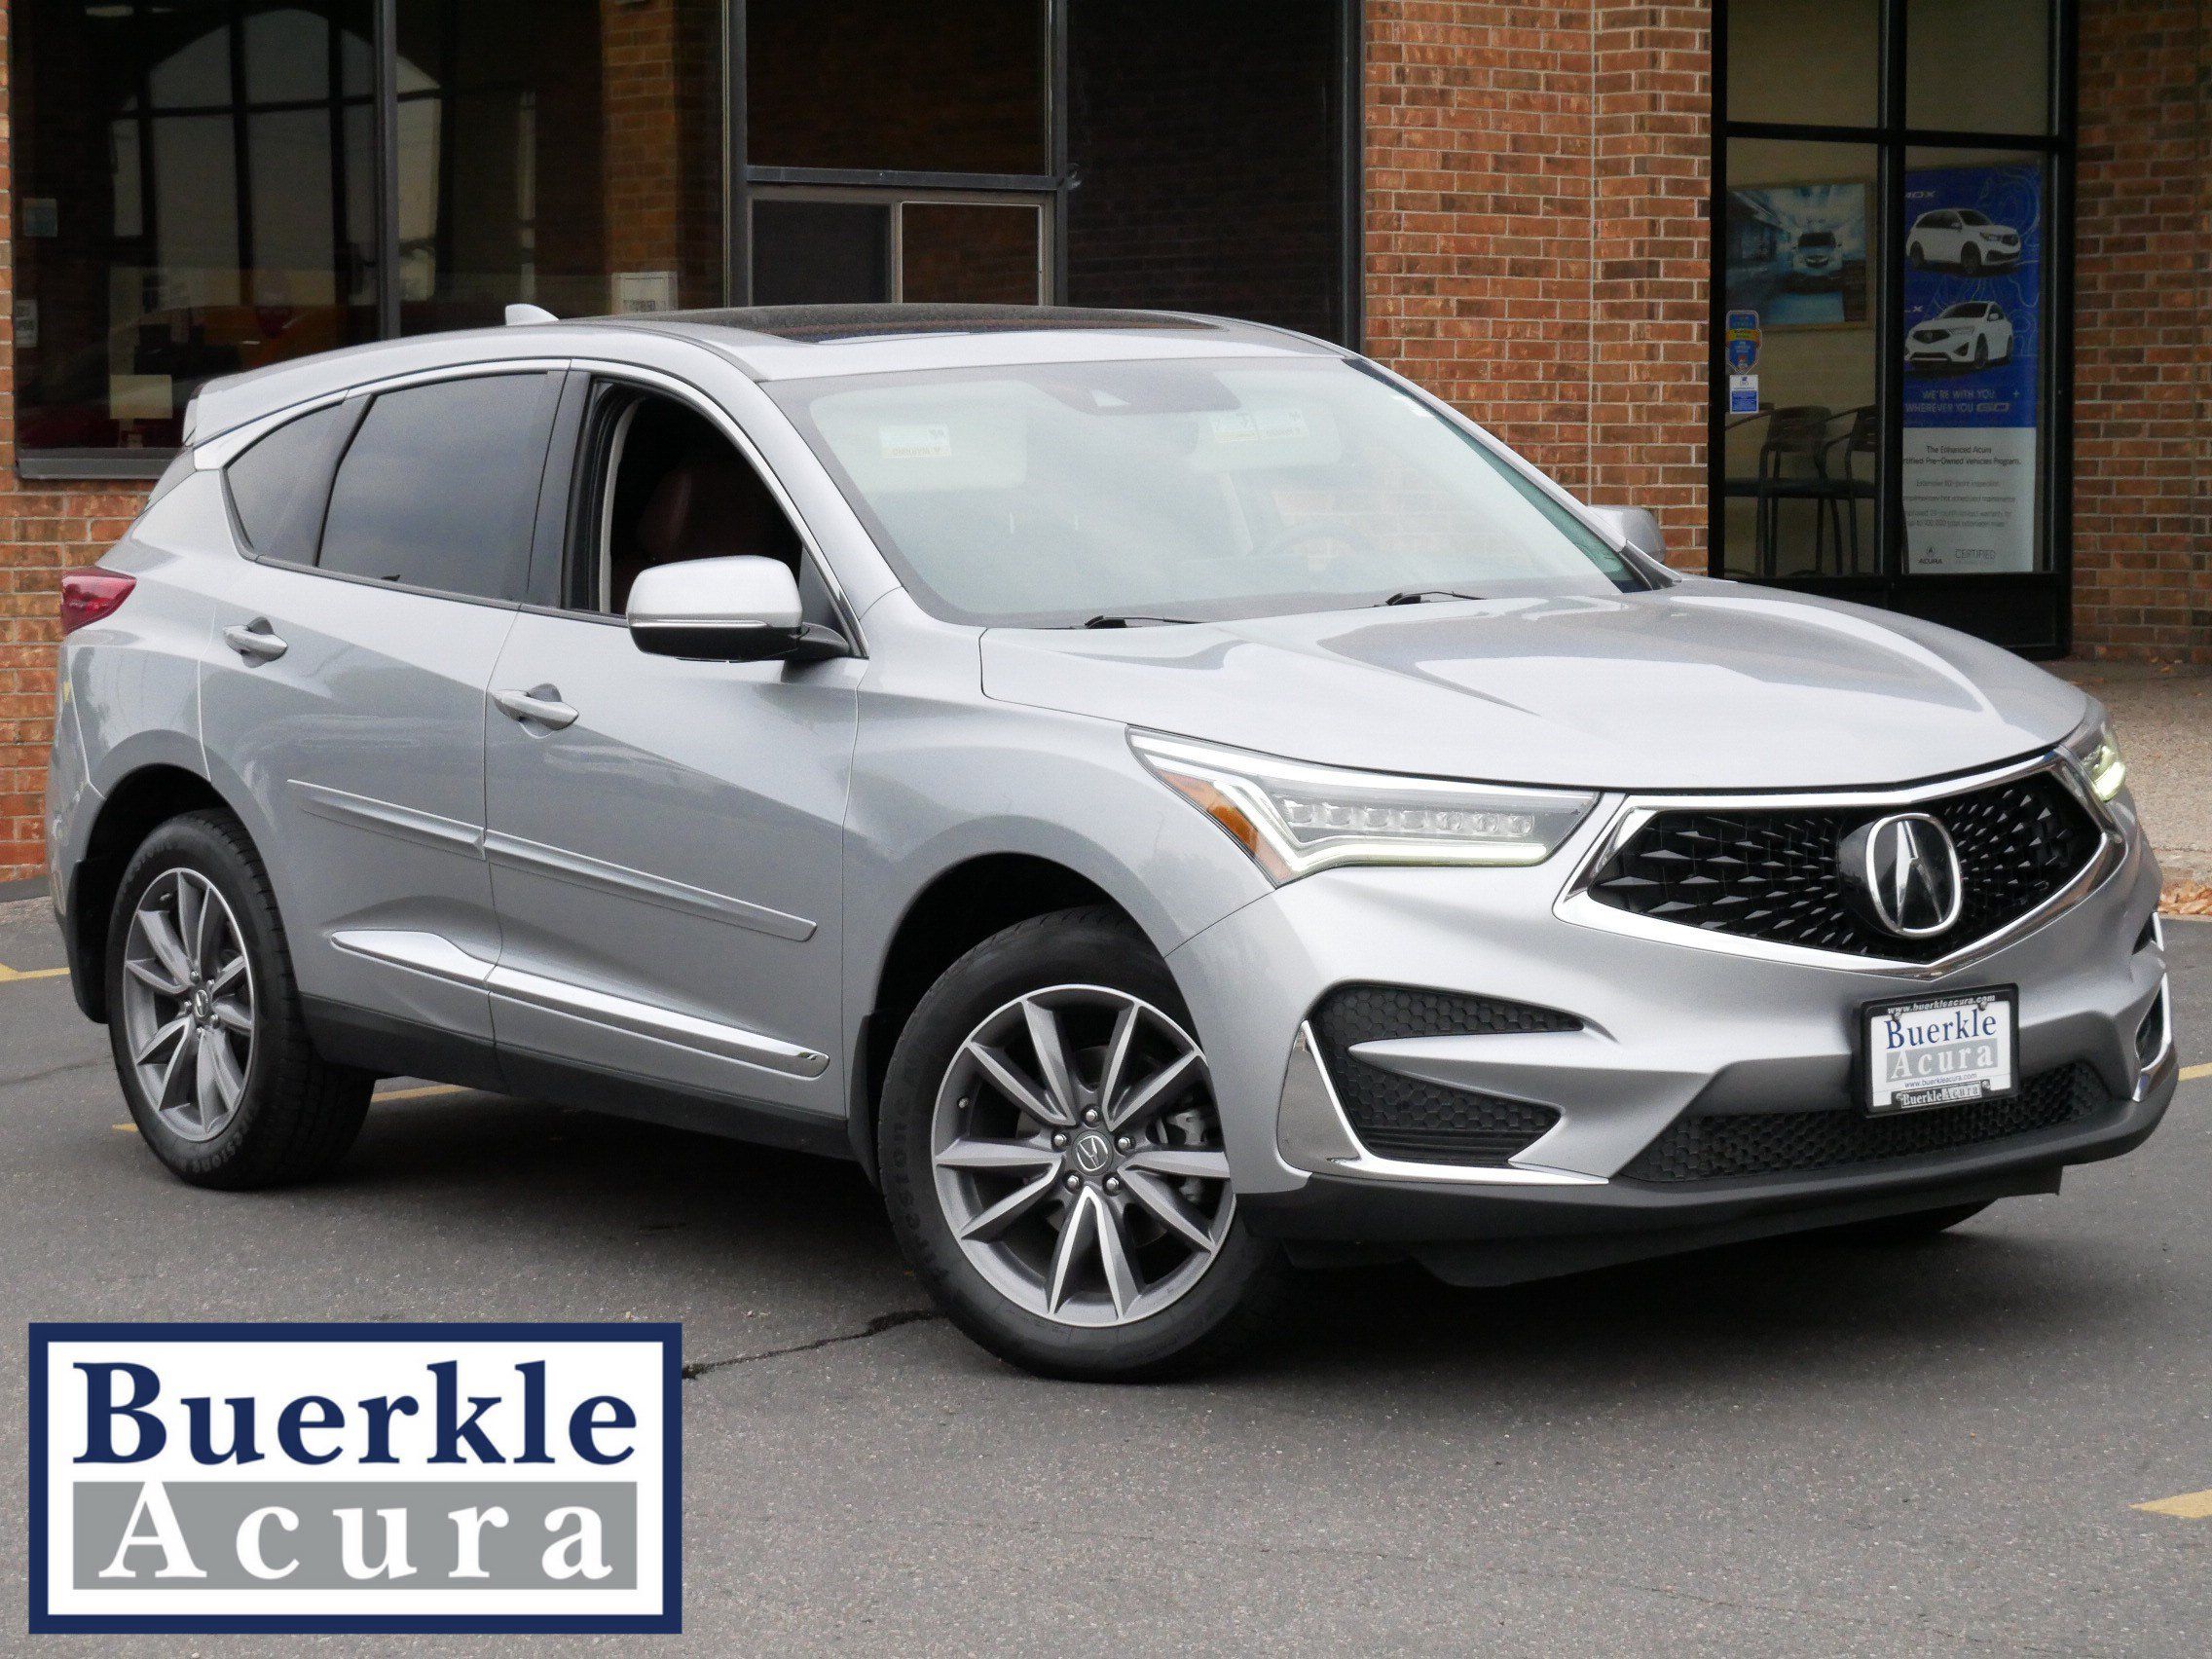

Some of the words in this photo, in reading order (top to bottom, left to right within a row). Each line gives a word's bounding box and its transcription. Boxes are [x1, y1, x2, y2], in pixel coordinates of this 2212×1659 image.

[1922, 389, 1949, 399] WE'RE
[1952, 389, 1974, 399] WITH
[1976, 389, 1996, 399] YOU
[1905, 402, 1953, 413] WHEREVER
[1956, 402, 1974, 413] YOU
[1927, 445, 1939, 454] The
[1940, 445, 1972, 454] Enhanced
[1972, 445, 1992, 454] Acura
[1926, 457, 1964, 465] Pre-Owned
[1966, 457, 1993, 465] Vehicles
[1955, 548, 1997, 560] CERTIFIED
[1888, 995, 1996, 1014] www.buerkleacura.com
[1884, 1009, 1997, 1050] Buerkle
[1891, 1045, 1994, 1079] Acura
[1904, 1073, 1977, 1088] www.buerkleacura.com
